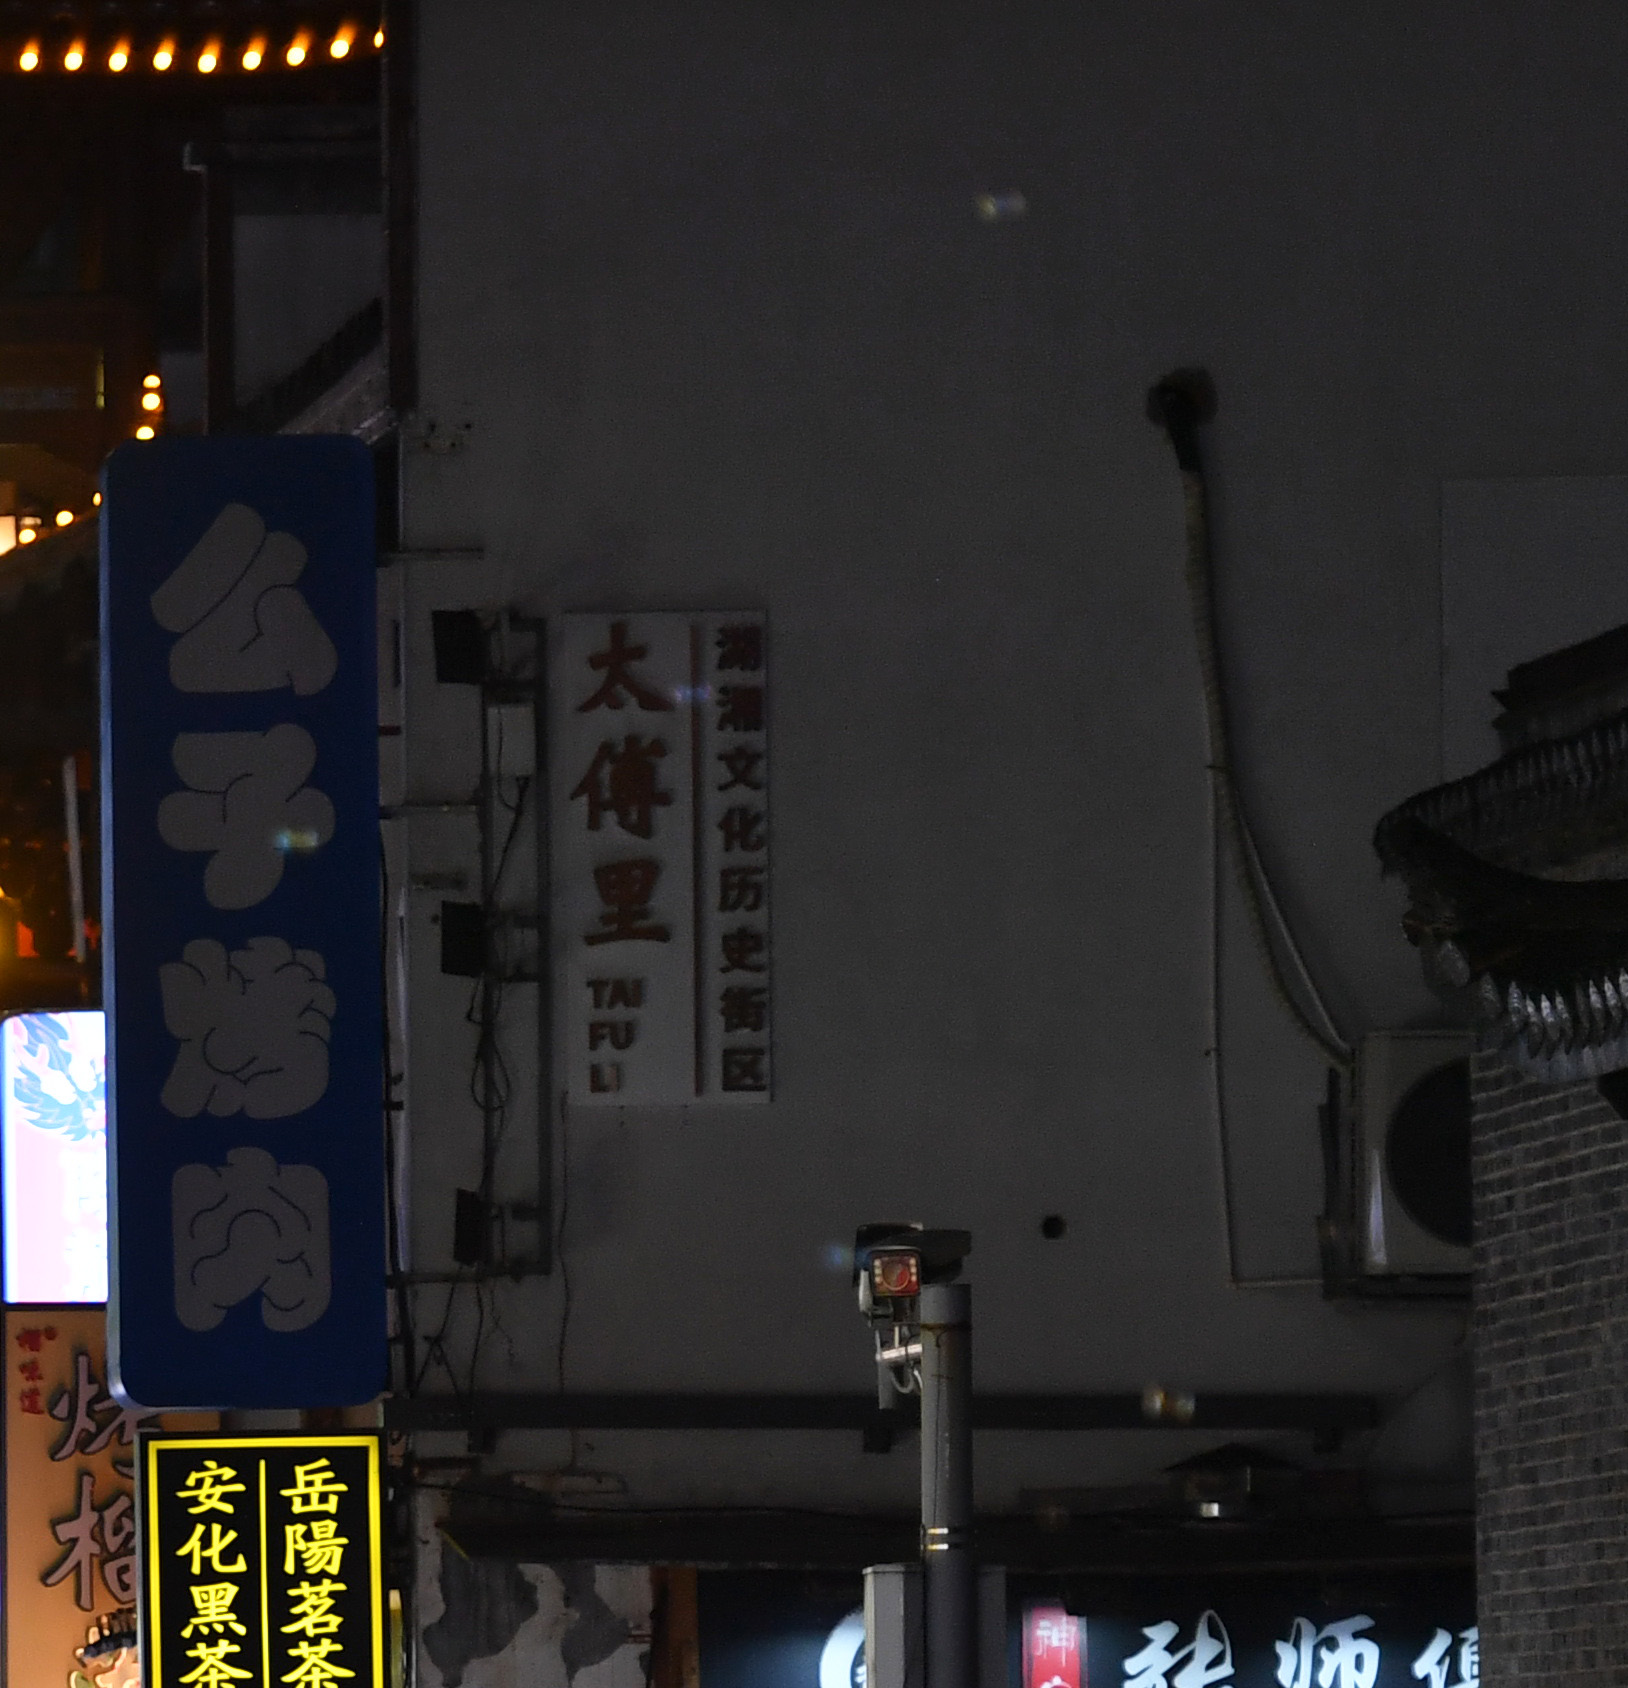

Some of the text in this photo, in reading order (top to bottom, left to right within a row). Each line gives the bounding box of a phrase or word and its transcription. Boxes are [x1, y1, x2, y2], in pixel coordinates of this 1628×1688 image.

[571, 622, 675, 945] 太傅里
[587, 977, 642, 1010] TAI
[588, 1020, 636, 1052] FU
